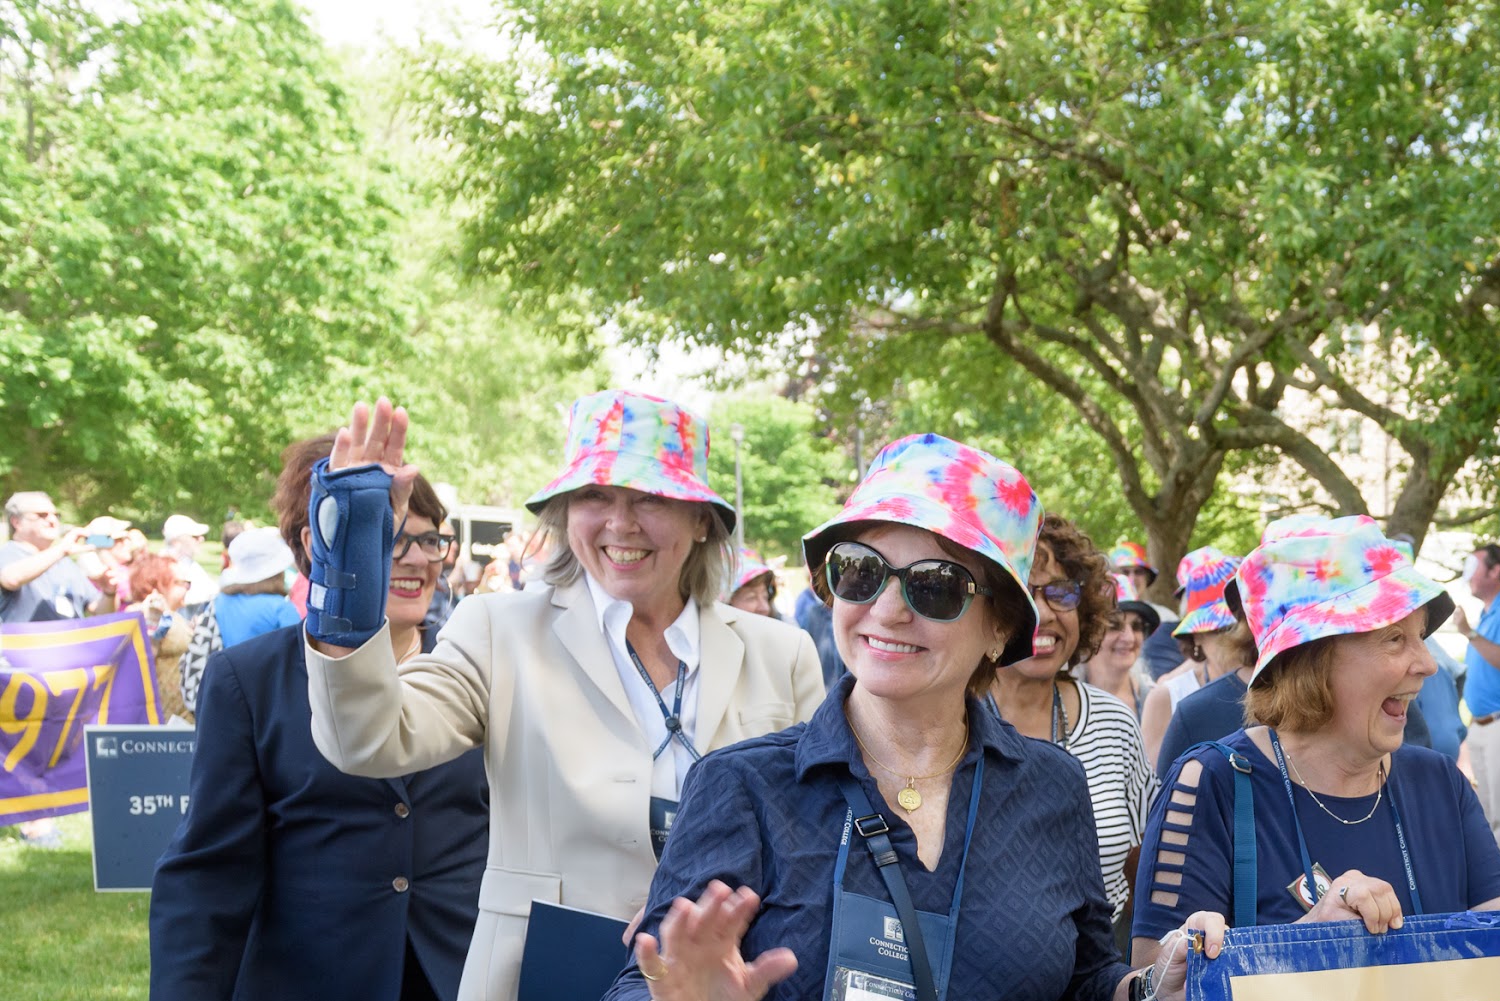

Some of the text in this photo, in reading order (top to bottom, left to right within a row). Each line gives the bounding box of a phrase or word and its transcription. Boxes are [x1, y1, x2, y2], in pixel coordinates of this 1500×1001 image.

[1272, 740, 1289, 779] CONNECTICUT
[841, 822, 852, 846] COLLEGE
[1402, 849, 1416, 891] CONNECTICUT
[878, 947, 909, 961] COLLEGE
